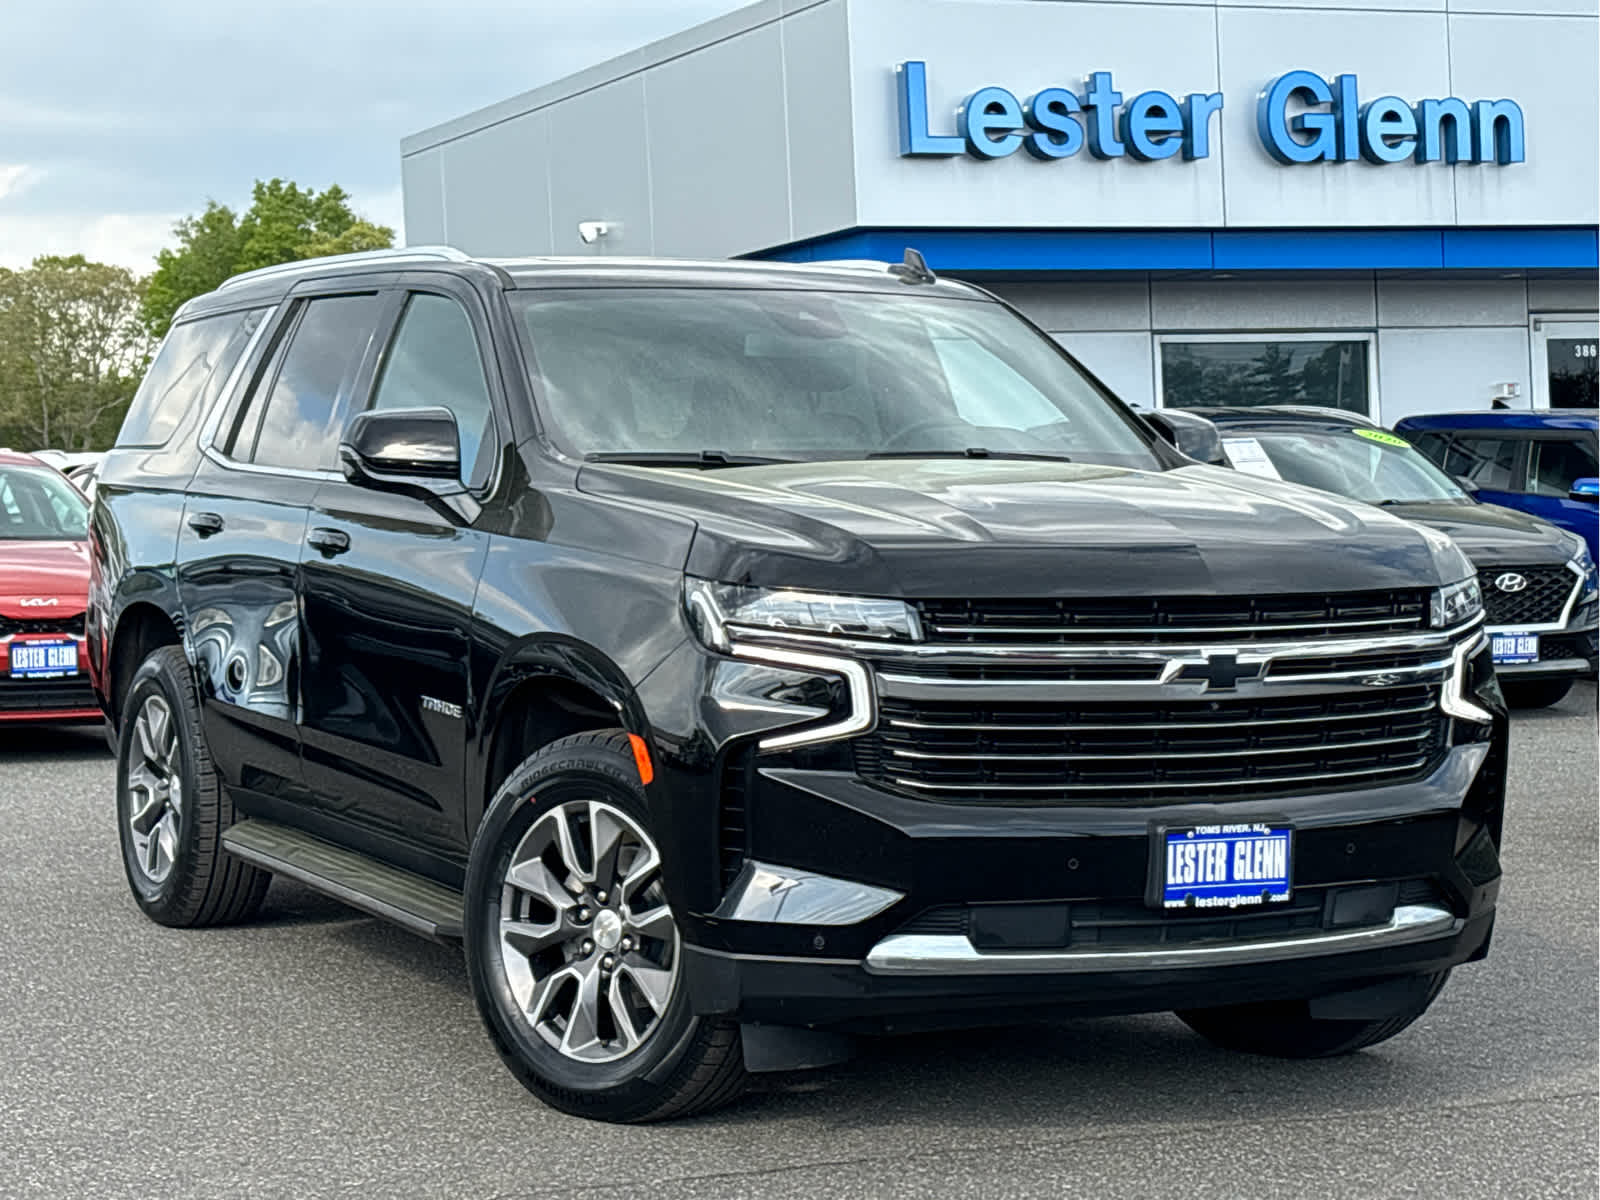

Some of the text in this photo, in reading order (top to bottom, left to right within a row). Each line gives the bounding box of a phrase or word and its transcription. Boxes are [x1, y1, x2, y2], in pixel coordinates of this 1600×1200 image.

[898, 60, 1525, 165] Lester Glenn
[1575, 344, 1597, 358] 386
[12, 646, 77, 669] LESTER GLENN
[421, 695, 463, 719] TAHOE
[1195, 825, 1221, 835] TOMS
[1167, 839, 1287, 885] LESTER GLENN
[1195, 894, 1262, 908] lesterglenn
